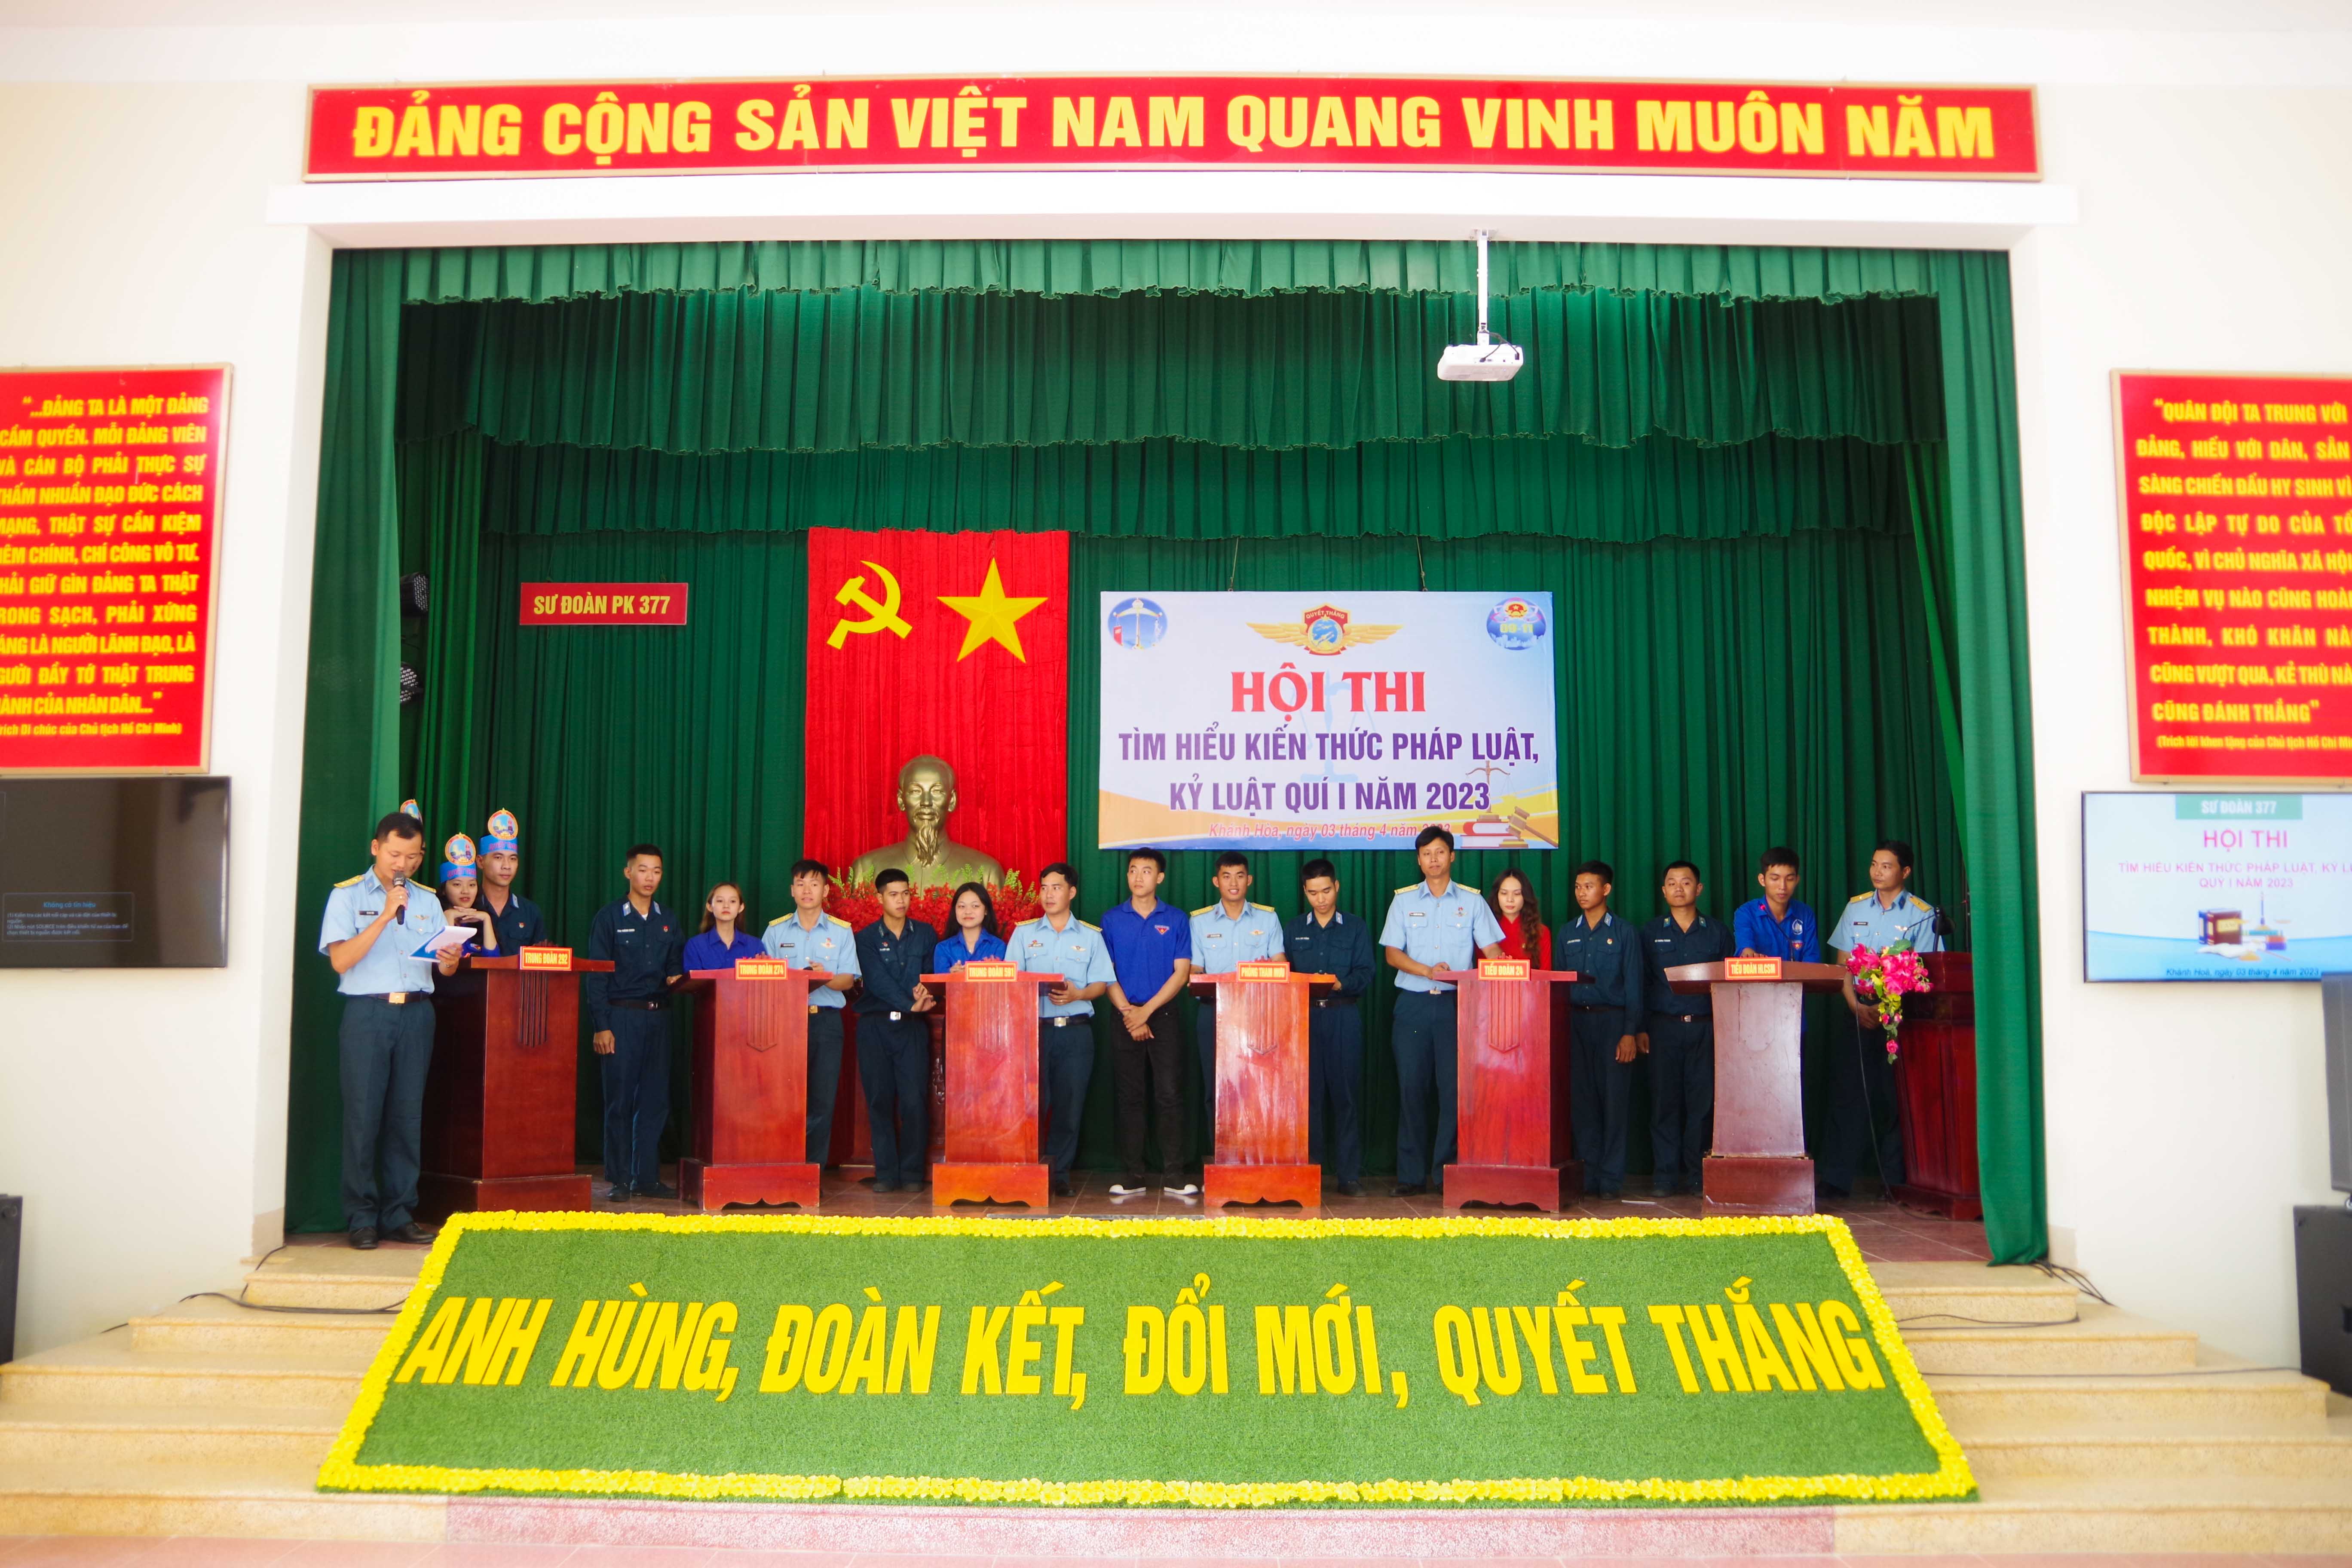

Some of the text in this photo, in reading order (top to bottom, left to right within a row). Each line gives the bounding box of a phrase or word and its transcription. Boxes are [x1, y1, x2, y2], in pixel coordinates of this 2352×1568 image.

[353, 84, 1994, 165] ĐẢNG CỘNG SẢN VIỆT NAM QUANG VINH MUÔN NĂM
[88, 399, 104, 415] TA
[2242, 404, 2260, 422] TA
[2264, 404, 2316, 423] TRUNG
[2294, 479, 2334, 496] SINH
[140, 576, 156, 592] TA
[534, 592, 670, 614] SƯ ĐOÀN PK 377
[146, 665, 194, 683] TRUNG
[1232, 663, 1425, 721] HỘI THI
[1119, 722, 1538, 766] TÌM HIỂU KIẾN THỨC PHÁP LUẬT,
[1171, 775, 1489, 816] KỶ LUẬT QUÍ I NĂM 2023
[2256, 801, 2277, 814] 377
[1209, 823, 1253, 837] Khánh
[1256, 824, 1281, 840] Hòa,
[1286, 824, 1317, 841] ngày
[1321, 824, 1335, 837] 03
[1339, 823, 1376, 842] tháng
[1379, 824, 1387, 836] 4
[1390, 823, 1417, 836] năm
[2252, 830, 2288, 848] THI
[2267, 879, 2294, 888] 2023
[525, 952, 567, 964] TRUNG ĐOÀN 292
[740, 963, 784, 974] TRUNG ĐOÀN 274
[969, 967, 987, 977] TRUNG
[988, 966, 1003, 977] ĐOÀN
[1259, 968, 1272, 977] THAM
[1498, 964, 1515, 975] ĐOÀN
[1516, 966, 1522, 975] 24
[1743, 963, 1757, 974] ĐOÀN
[394, 1273, 1886, 1409] ANH HÙNG, ĐOÀN KẾT, ĐỔI MỚI, QUYẾT THẮNG
